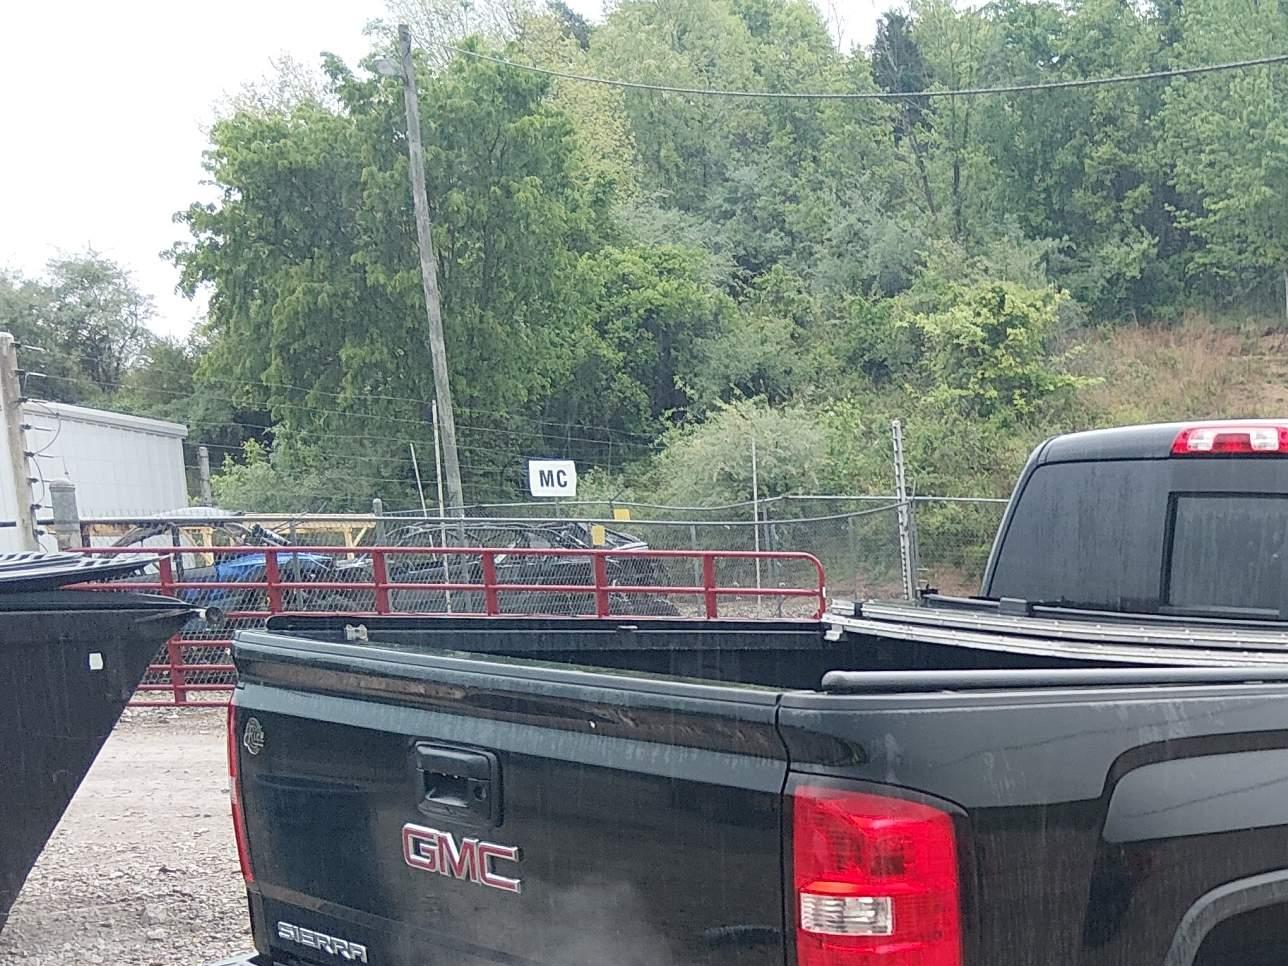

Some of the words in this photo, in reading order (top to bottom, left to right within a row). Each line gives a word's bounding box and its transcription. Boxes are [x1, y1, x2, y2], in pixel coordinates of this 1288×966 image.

[538, 469, 568, 488] MC
[402, 823, 521, 894] GMC
[277, 921, 368, 964] SIERRA
